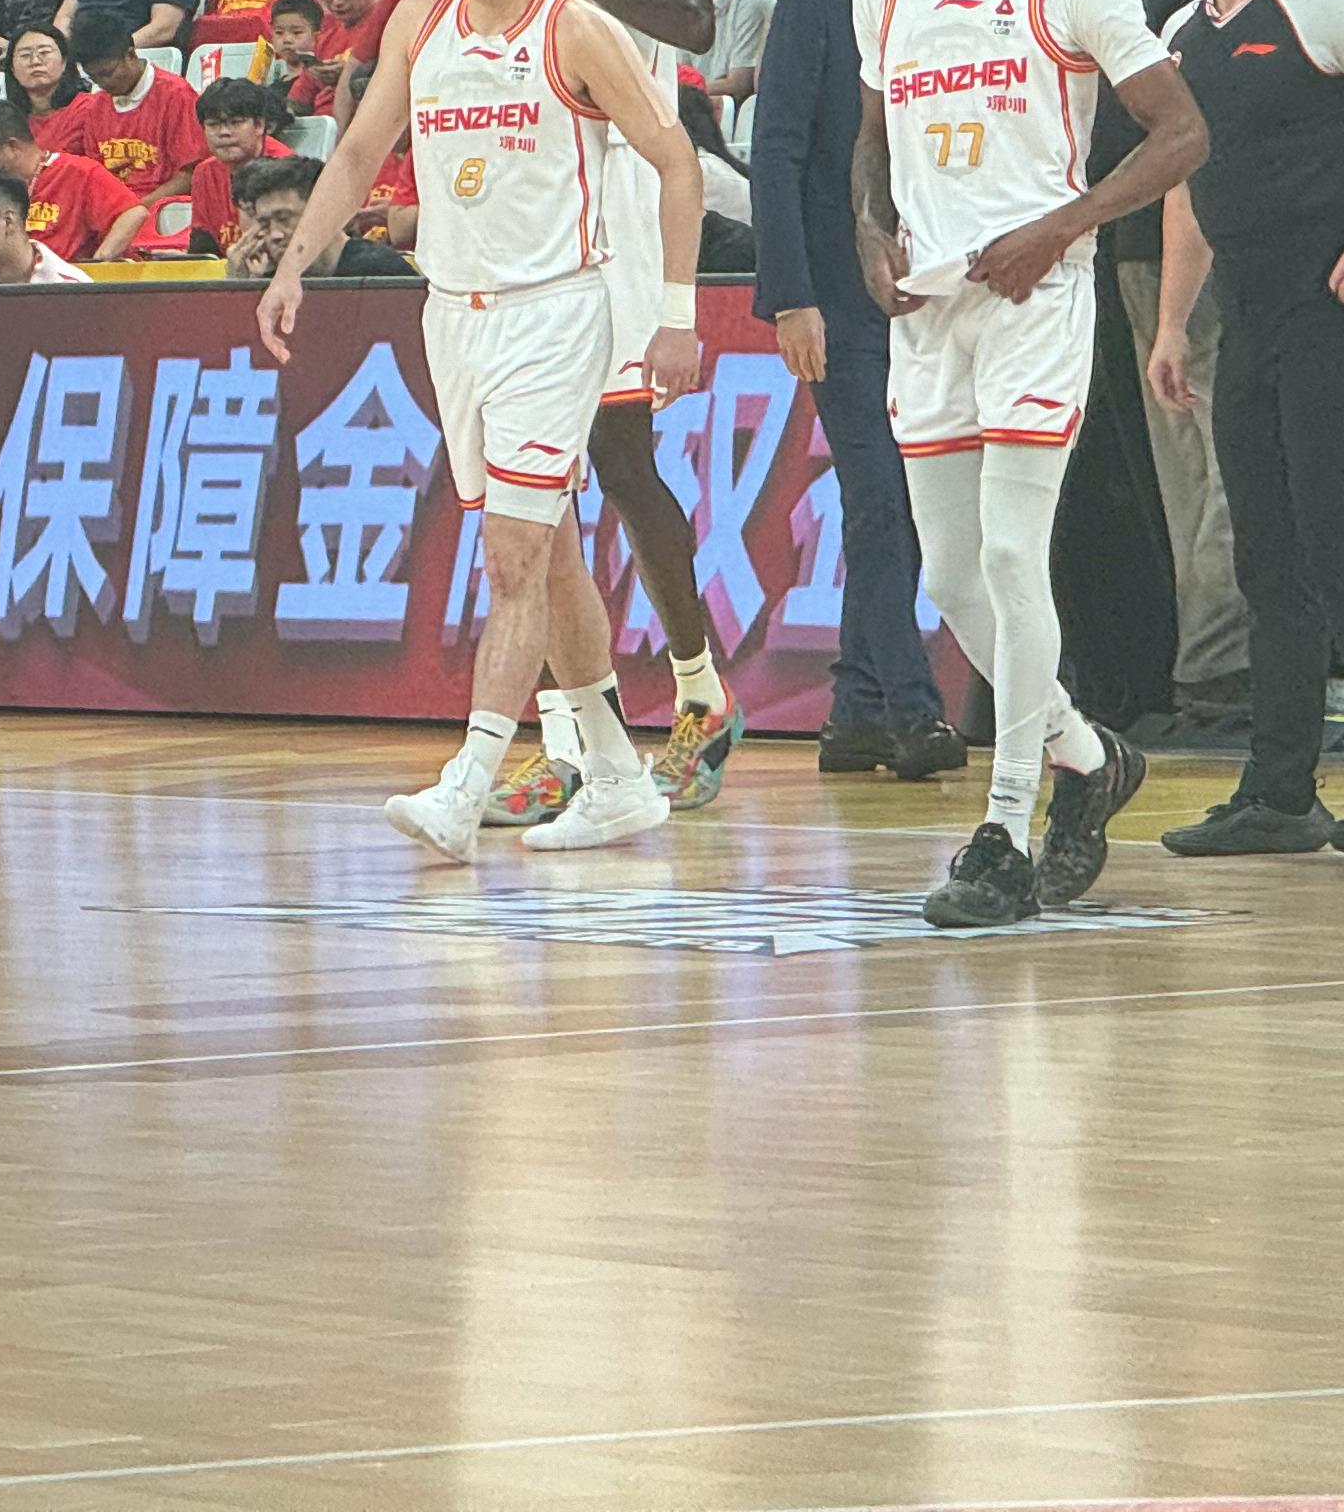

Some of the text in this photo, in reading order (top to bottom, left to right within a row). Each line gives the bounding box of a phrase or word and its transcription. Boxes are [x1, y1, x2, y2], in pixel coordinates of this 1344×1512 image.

[889, 57, 1028, 108] SHENZHEN
[416, 101, 541, 139] SHENZHEN
[925, 121, 986, 168] 77
[454, 156, 487, 197] 8
